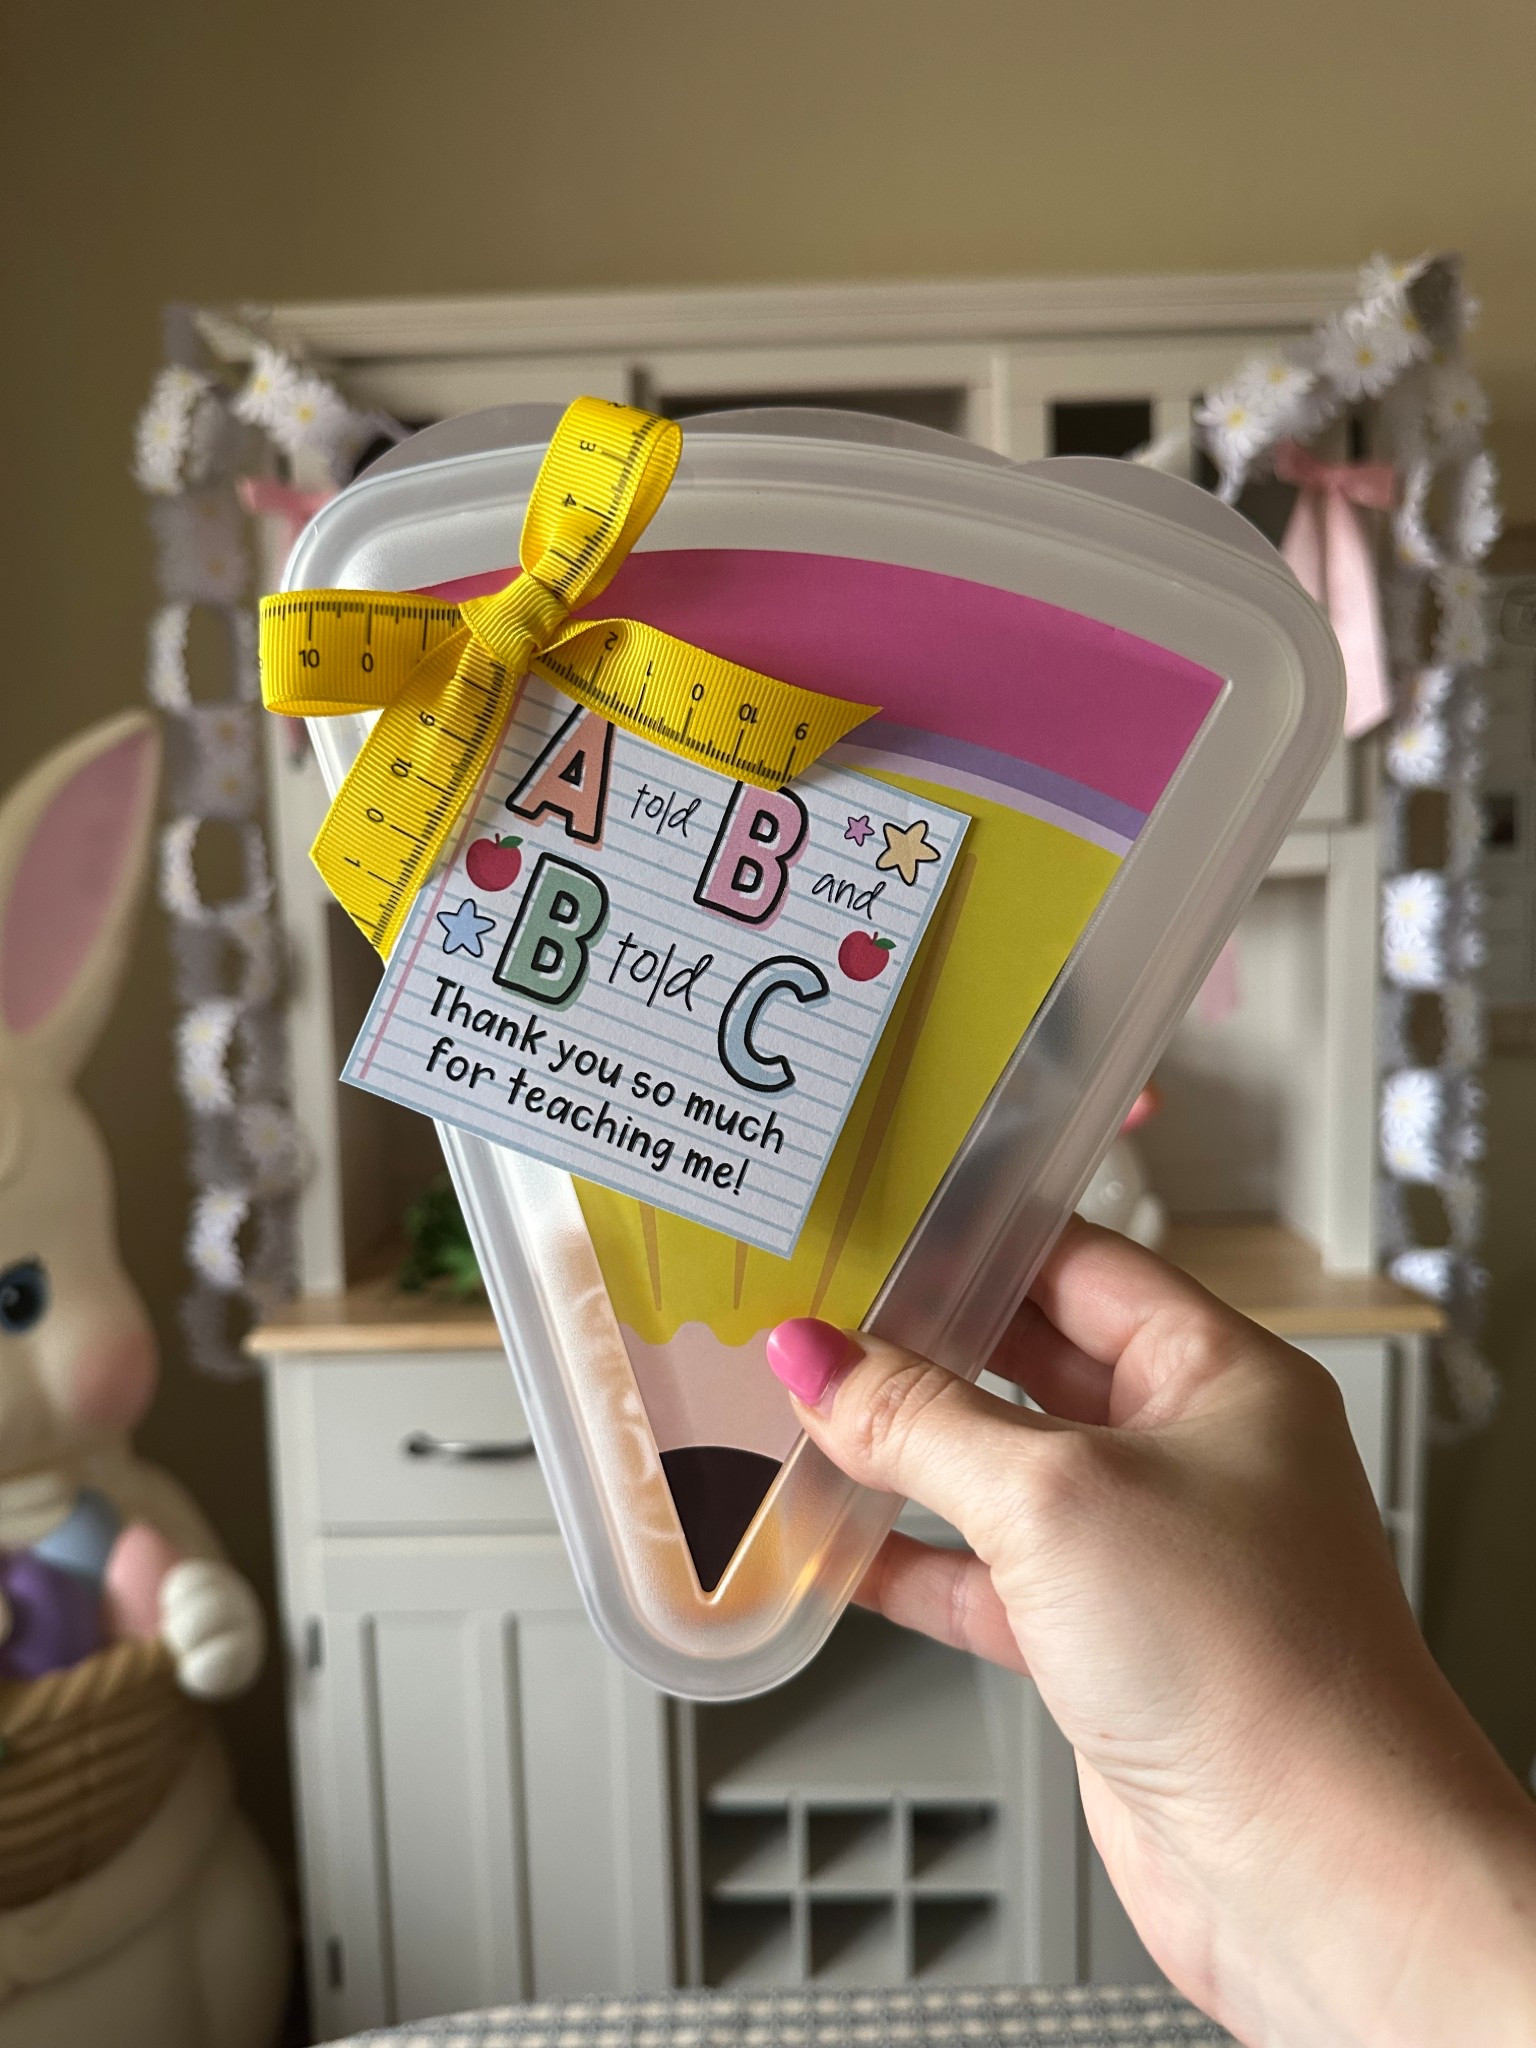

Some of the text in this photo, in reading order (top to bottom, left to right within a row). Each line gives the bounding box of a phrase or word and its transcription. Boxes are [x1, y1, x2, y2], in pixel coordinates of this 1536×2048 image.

[579, 439, 597, 453] 3
[562, 493, 577, 508] 4
[604, 631, 618, 651] 2
[298, 648, 374, 673] 10 0
[691, 682, 704, 702] 0
[738, 702, 758, 725] 10
[390, 757, 414, 779] 10
[366, 807, 385, 824] 0
[506, 704, 887, 931] A told B and
[344, 856, 362, 869] 1
[493, 851, 830, 1093] B told C
[429, 975, 786, 1155] Thank you so much
[425, 1036, 751, 1196] for teaching me!
